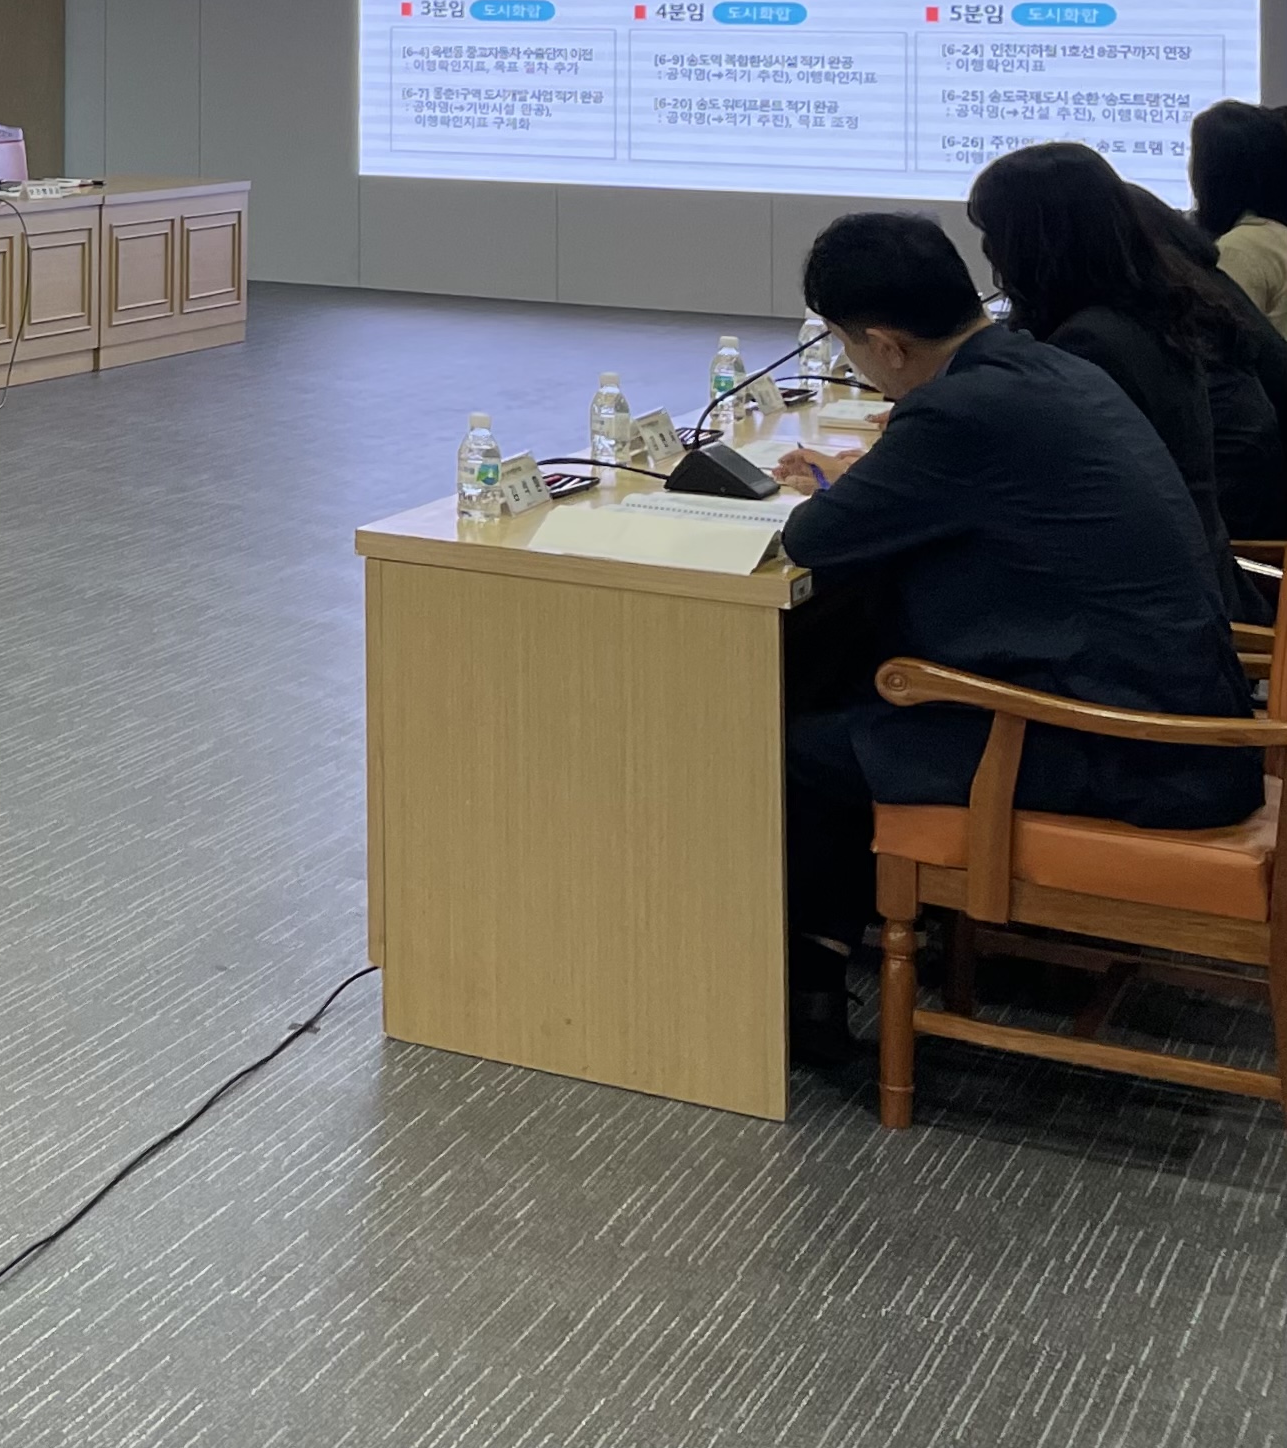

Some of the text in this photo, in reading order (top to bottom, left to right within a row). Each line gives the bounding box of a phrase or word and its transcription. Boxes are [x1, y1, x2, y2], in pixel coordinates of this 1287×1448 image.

[421, 0, 542, 18] 3분임 도시화합
[656, 3, 792, 22] 4분임 도시화합
[950, 5, 1099, 24] 5분임 도시화합
[942, 44, 984, 57] [6-24]
[956, 57, 1045, 73] 이행확인지표
[942, 90, 984, 104] [6-25]
[942, 136, 984, 150] [6-26]
